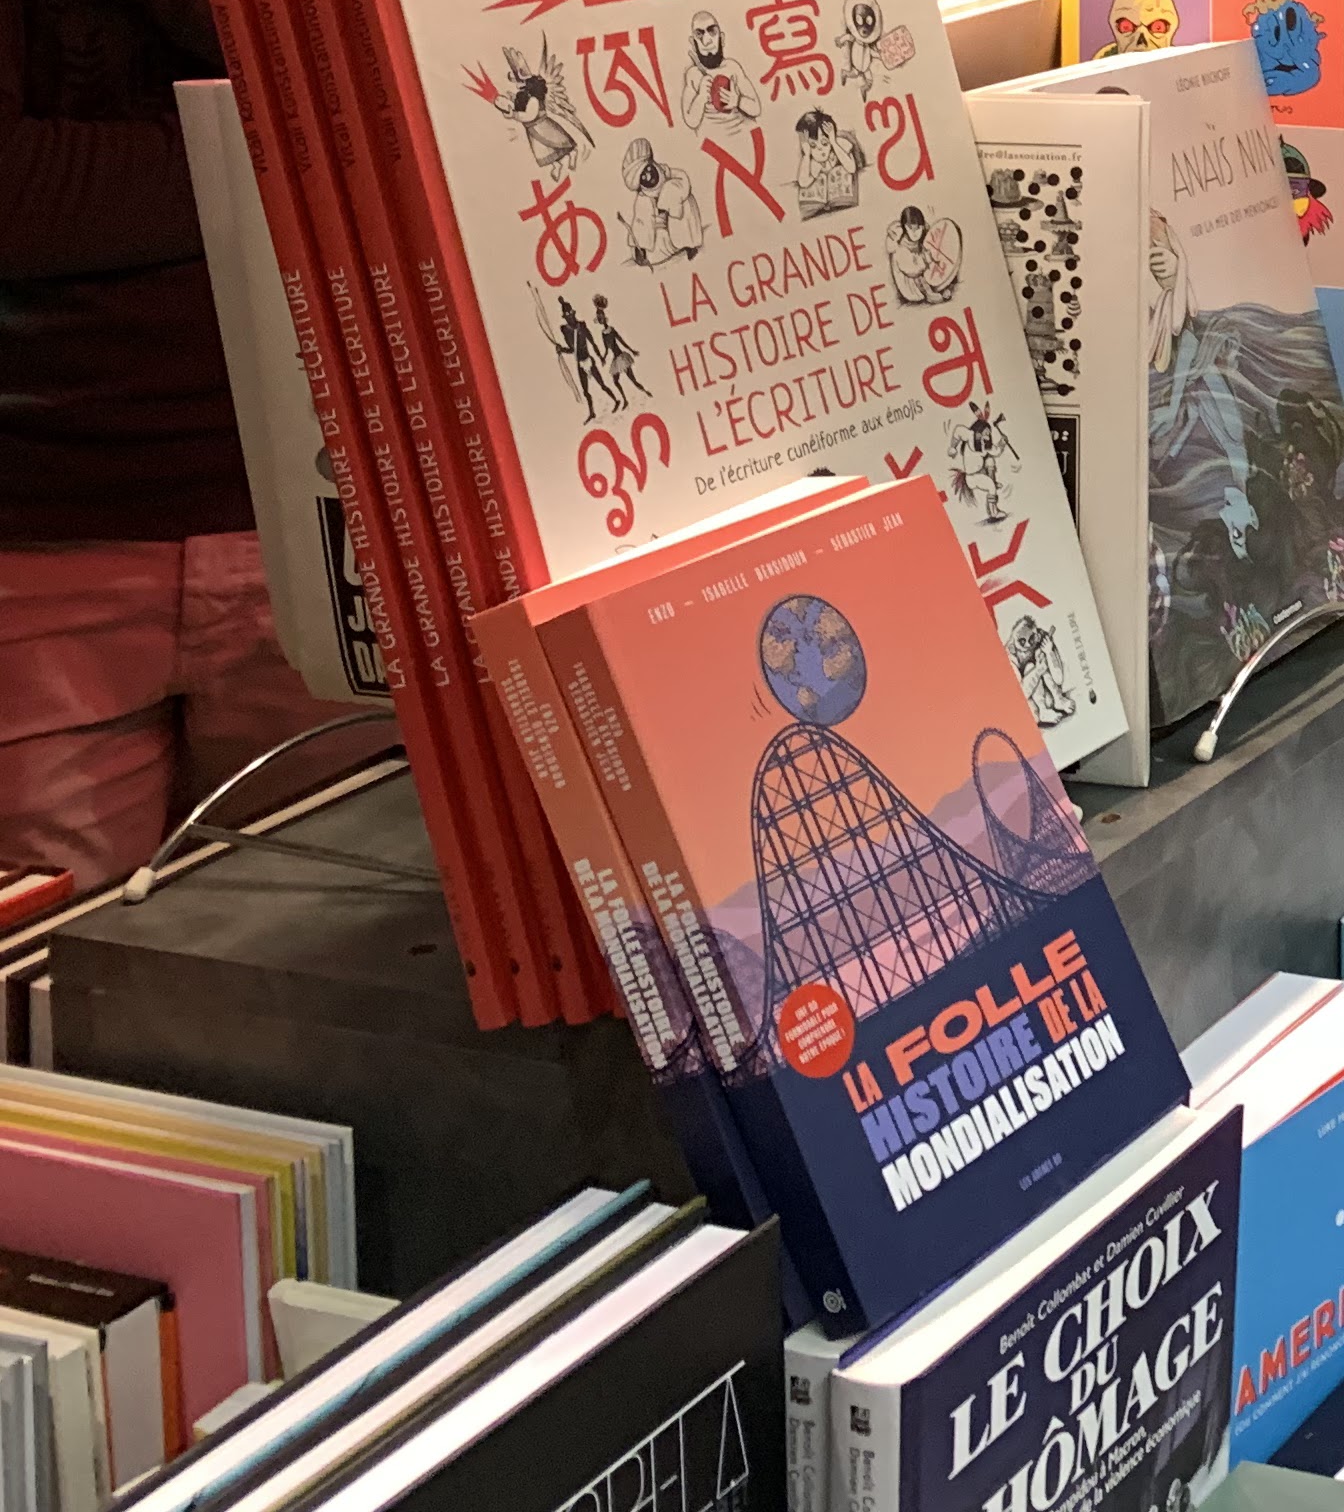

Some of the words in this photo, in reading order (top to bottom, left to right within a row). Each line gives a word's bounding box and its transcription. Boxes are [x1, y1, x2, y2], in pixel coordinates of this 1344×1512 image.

[1172, 122, 1234, 202] ANAÏS
[1236, 125, 1276, 178] NIN
[519, 177, 608, 288] あ
[660, 281, 710, 327] LA
[728, 225, 874, 311] GRANDE
[670, 307, 837, 398] HISTOIRE
[847, 282, 895, 334] DE
[323, 406, 342, 438] DE
[368, 403, 385, 434] DE
[694, 474, 718, 497] De
[720, 449, 785, 488] l'écriture
[786, 426, 860, 471] cunéiforme
[860, 418, 886, 441] aux
[887, 402, 925, 434] émojis
[697, 345, 902, 459] L'ÉCRITURE
[327, 445, 371, 549] HISTOIRE
[373, 443, 414, 546] HISTOIRE
[403, 556, 441, 647] GRANDE
[648, 598, 677, 626] ENZO
[435, 654, 450, 687] LA
[842, 1070, 884, 1113] LA
[885, 930, 1089, 1083] FOLLE
[860, 1013, 1041, 1162] HISTOIRE
[1040, 989, 1077, 1044] DE
[1077, 970, 1109, 1021] LA
[881, 1014, 1126, 1212] MONDIALISATION
[1038, 1267, 1093, 1322] Collombat
[1106, 1222, 1144, 1265] Damien
[947, 1354, 1026, 1481] LE
[1042, 1180, 1223, 1383] CHOIX
[1070, 1337, 1119, 1416] DU
[982, 1282, 1224, 1512] HÔMAGE
